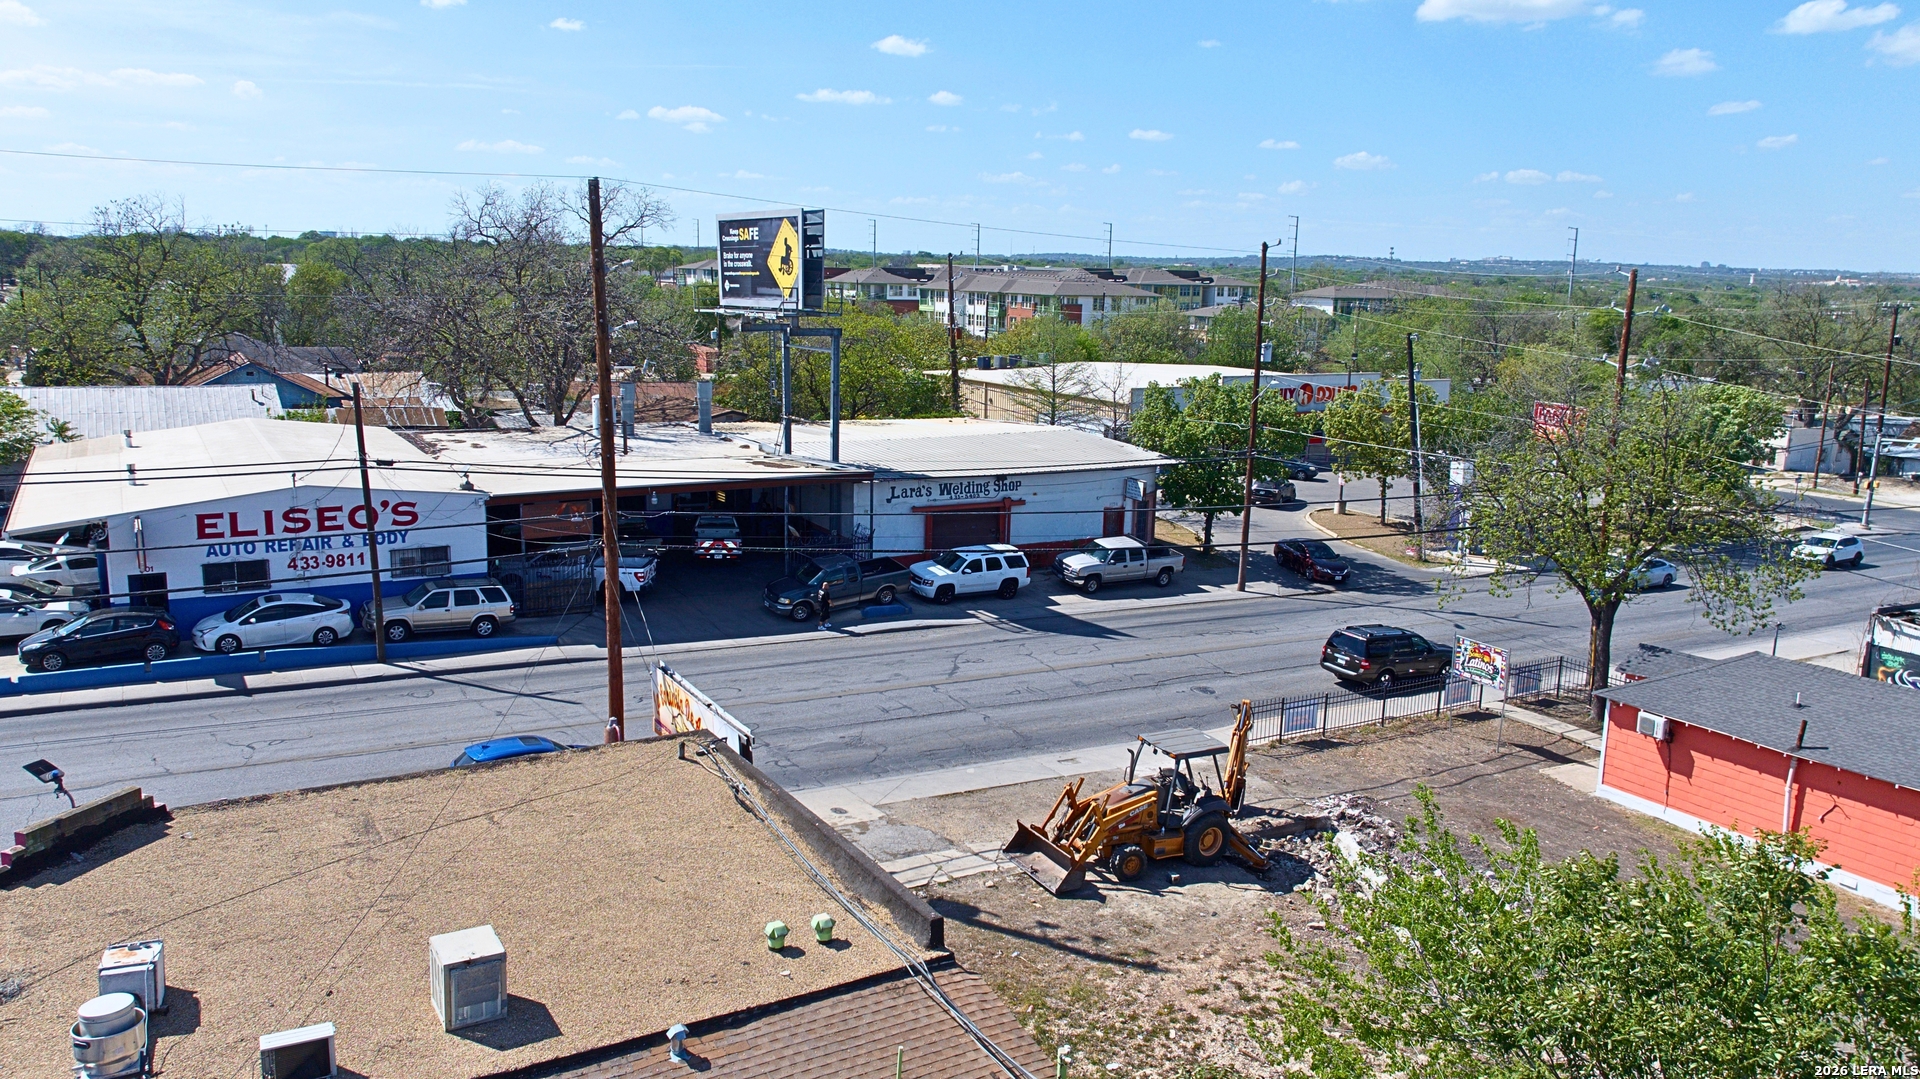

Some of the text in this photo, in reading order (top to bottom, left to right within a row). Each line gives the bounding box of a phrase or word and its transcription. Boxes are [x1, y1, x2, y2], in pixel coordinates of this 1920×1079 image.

[738, 227, 759, 241] SAFE
[889, 484, 932, 499] Lara's
[938, 480, 991, 496] Welding
[195, 499, 419, 540] ELISEO'S
[206, 530, 409, 558] AUTO REPAIR & BODY
[287, 551, 366, 571] 433-9811
[1465, 653, 1494, 674] Latinos
